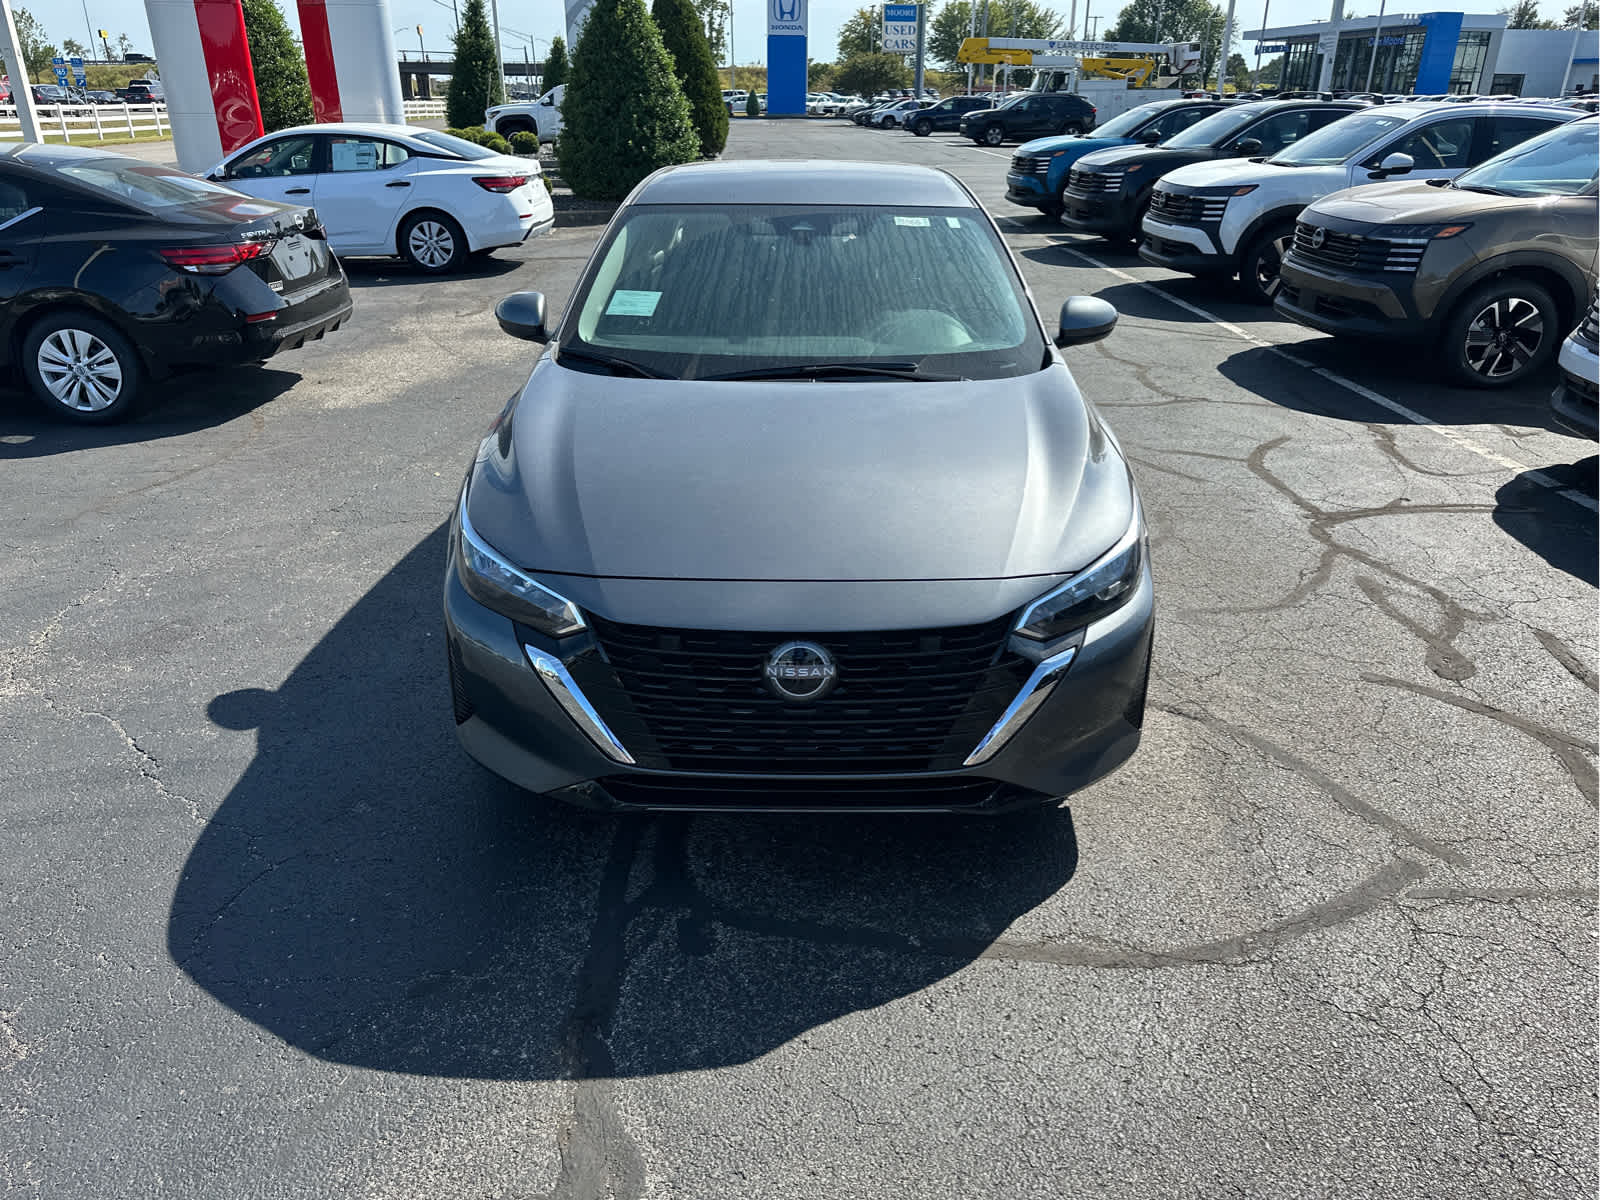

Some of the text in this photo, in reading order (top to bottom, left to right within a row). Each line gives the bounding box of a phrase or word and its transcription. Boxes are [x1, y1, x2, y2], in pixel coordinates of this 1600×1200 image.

[886, 8, 916, 17] MOORE
[885, 24, 916, 36] USED
[884, 39, 916, 49] CARS
[1384, 35, 1406, 46] Moore
[1081, 42, 1119, 51] ELECTRIC
[240, 229, 272, 239] SENTRA
[767, 666, 834, 677] NISSAN
